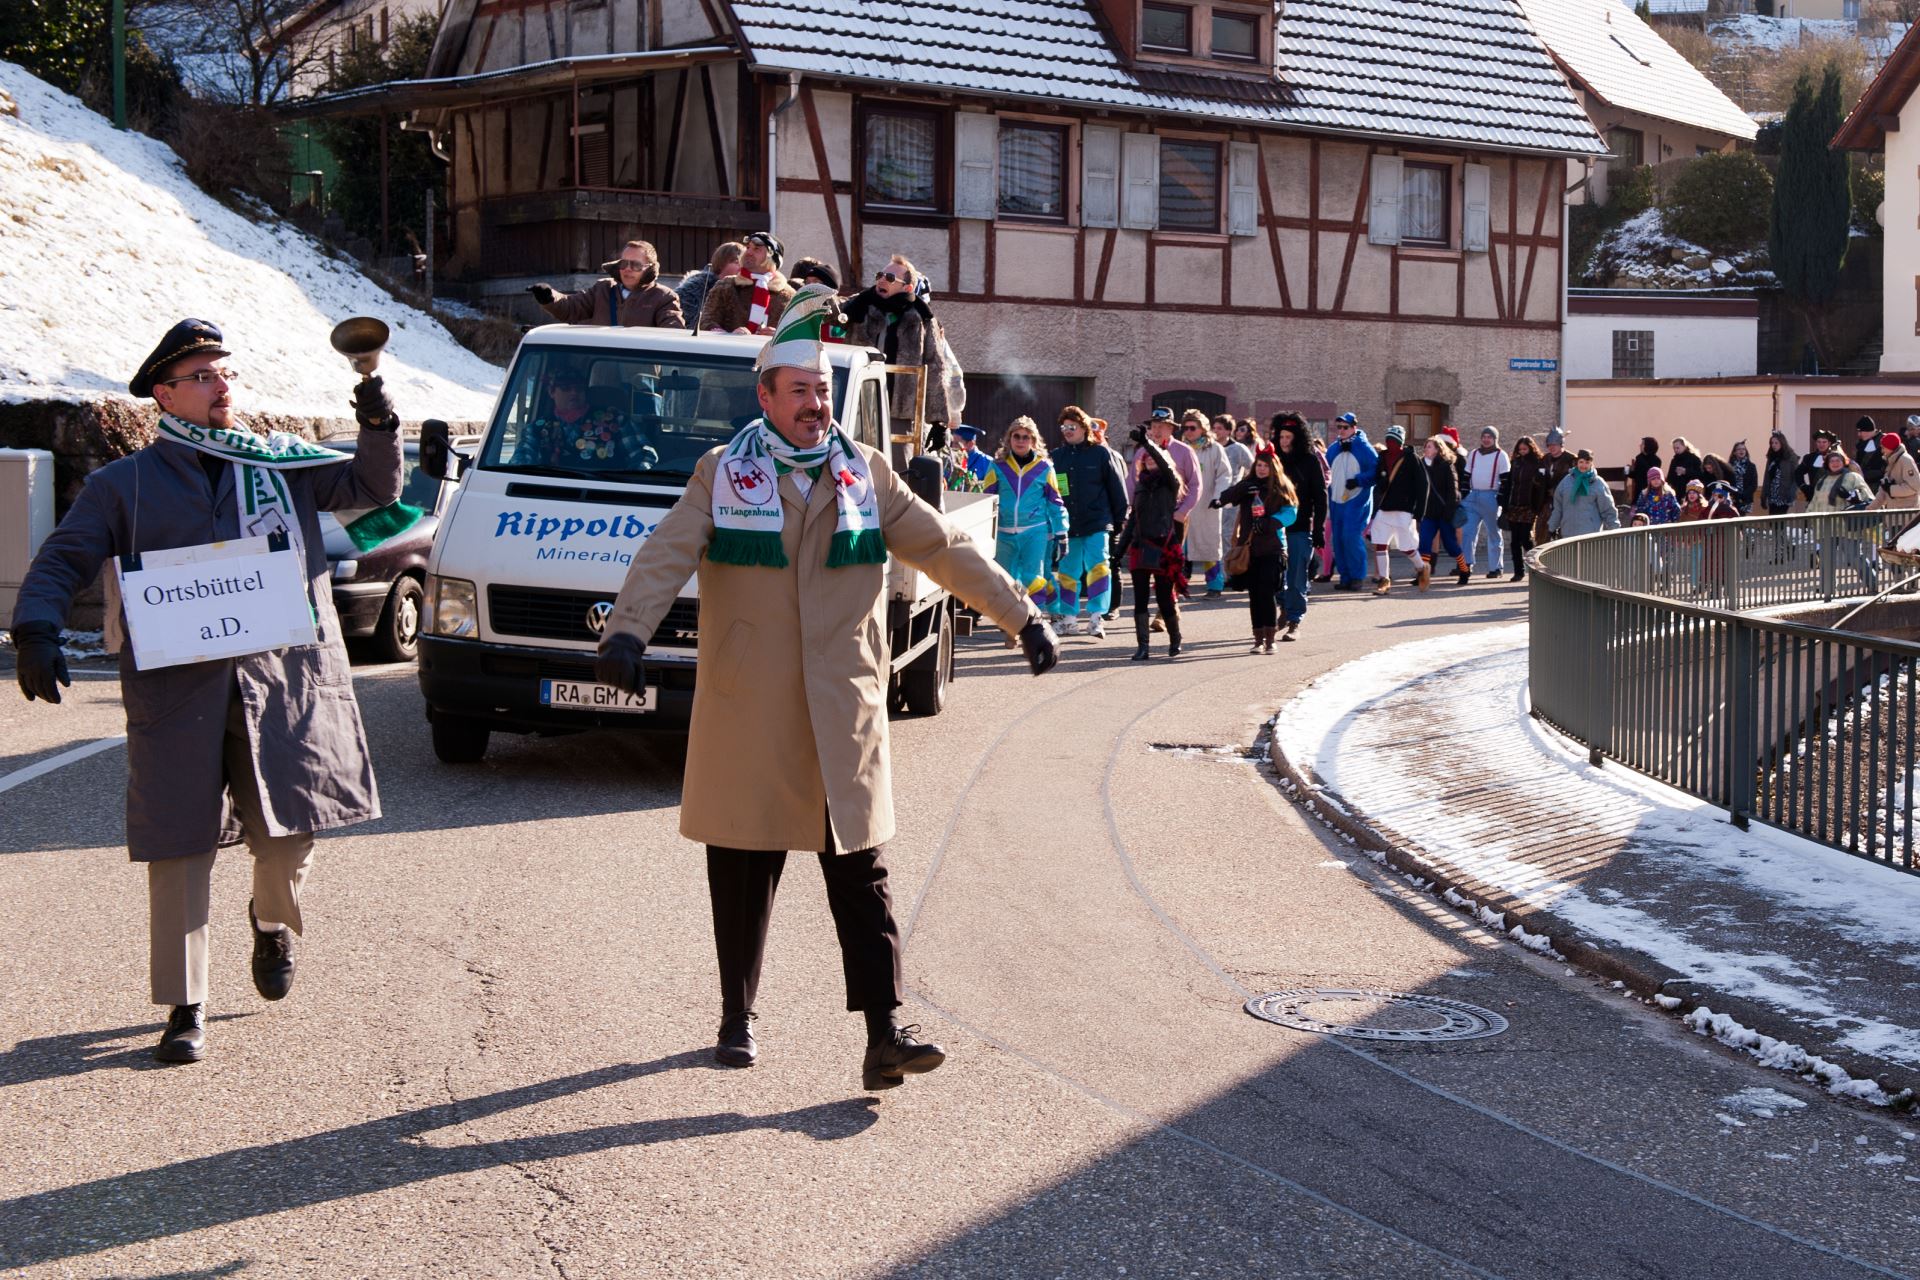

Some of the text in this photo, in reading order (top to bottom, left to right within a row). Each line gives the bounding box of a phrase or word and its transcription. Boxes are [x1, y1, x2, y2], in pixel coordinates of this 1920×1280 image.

[718, 506, 780, 518] TV Langenbrand
[144, 570, 265, 606] Ortsbüttel
[200, 616, 249, 641] a.D.
